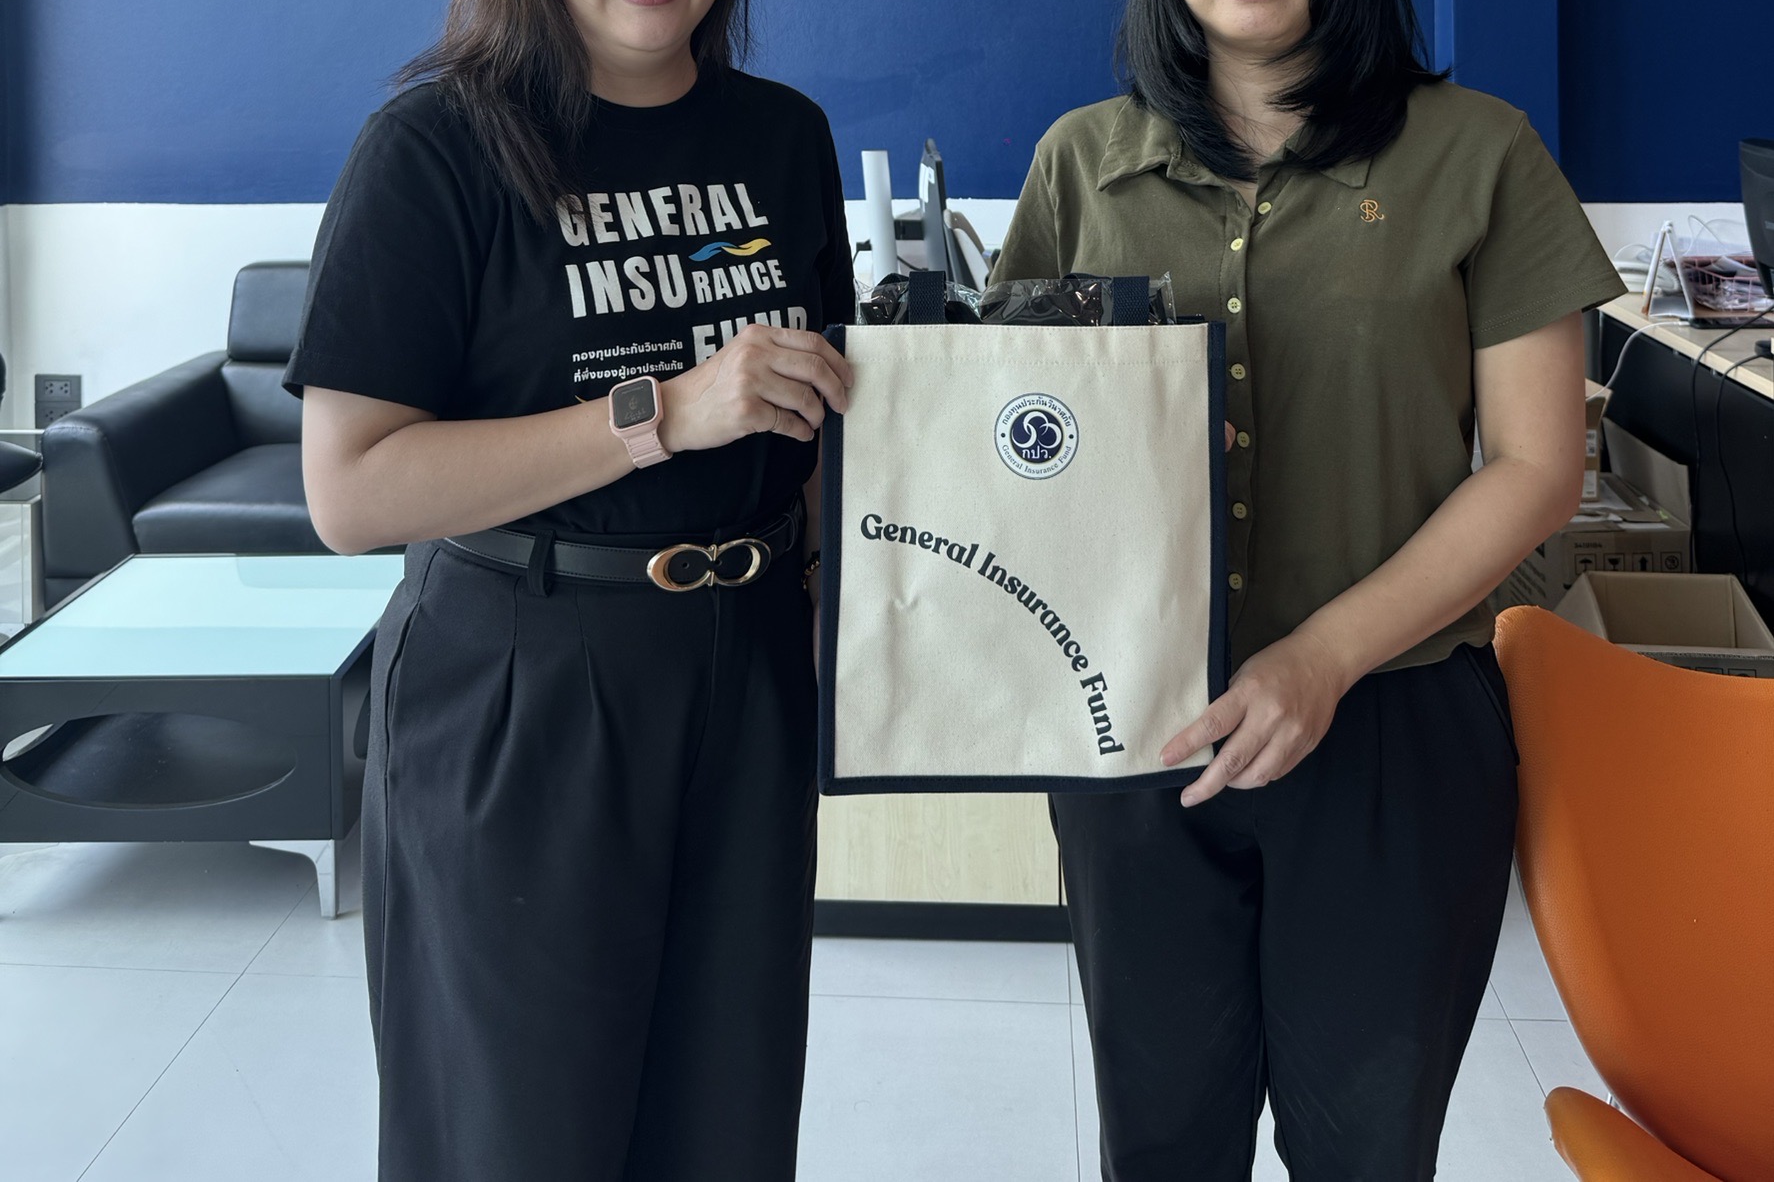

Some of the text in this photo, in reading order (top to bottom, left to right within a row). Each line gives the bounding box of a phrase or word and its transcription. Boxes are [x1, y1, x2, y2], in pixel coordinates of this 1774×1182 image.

[555, 183, 769, 247] GENERAL
[572, 339, 684, 362] กองทุนประกันวินาศภัย
[573, 360, 684, 382] ที่พึ่งของผู้เอาประกันภัย
[1002, 396, 1072, 427] กองทุนประกันวินาศภัย
[1002, 444, 1072, 474] General Insurance Fund
[860, 513, 1125, 756] General Insurance Fund
